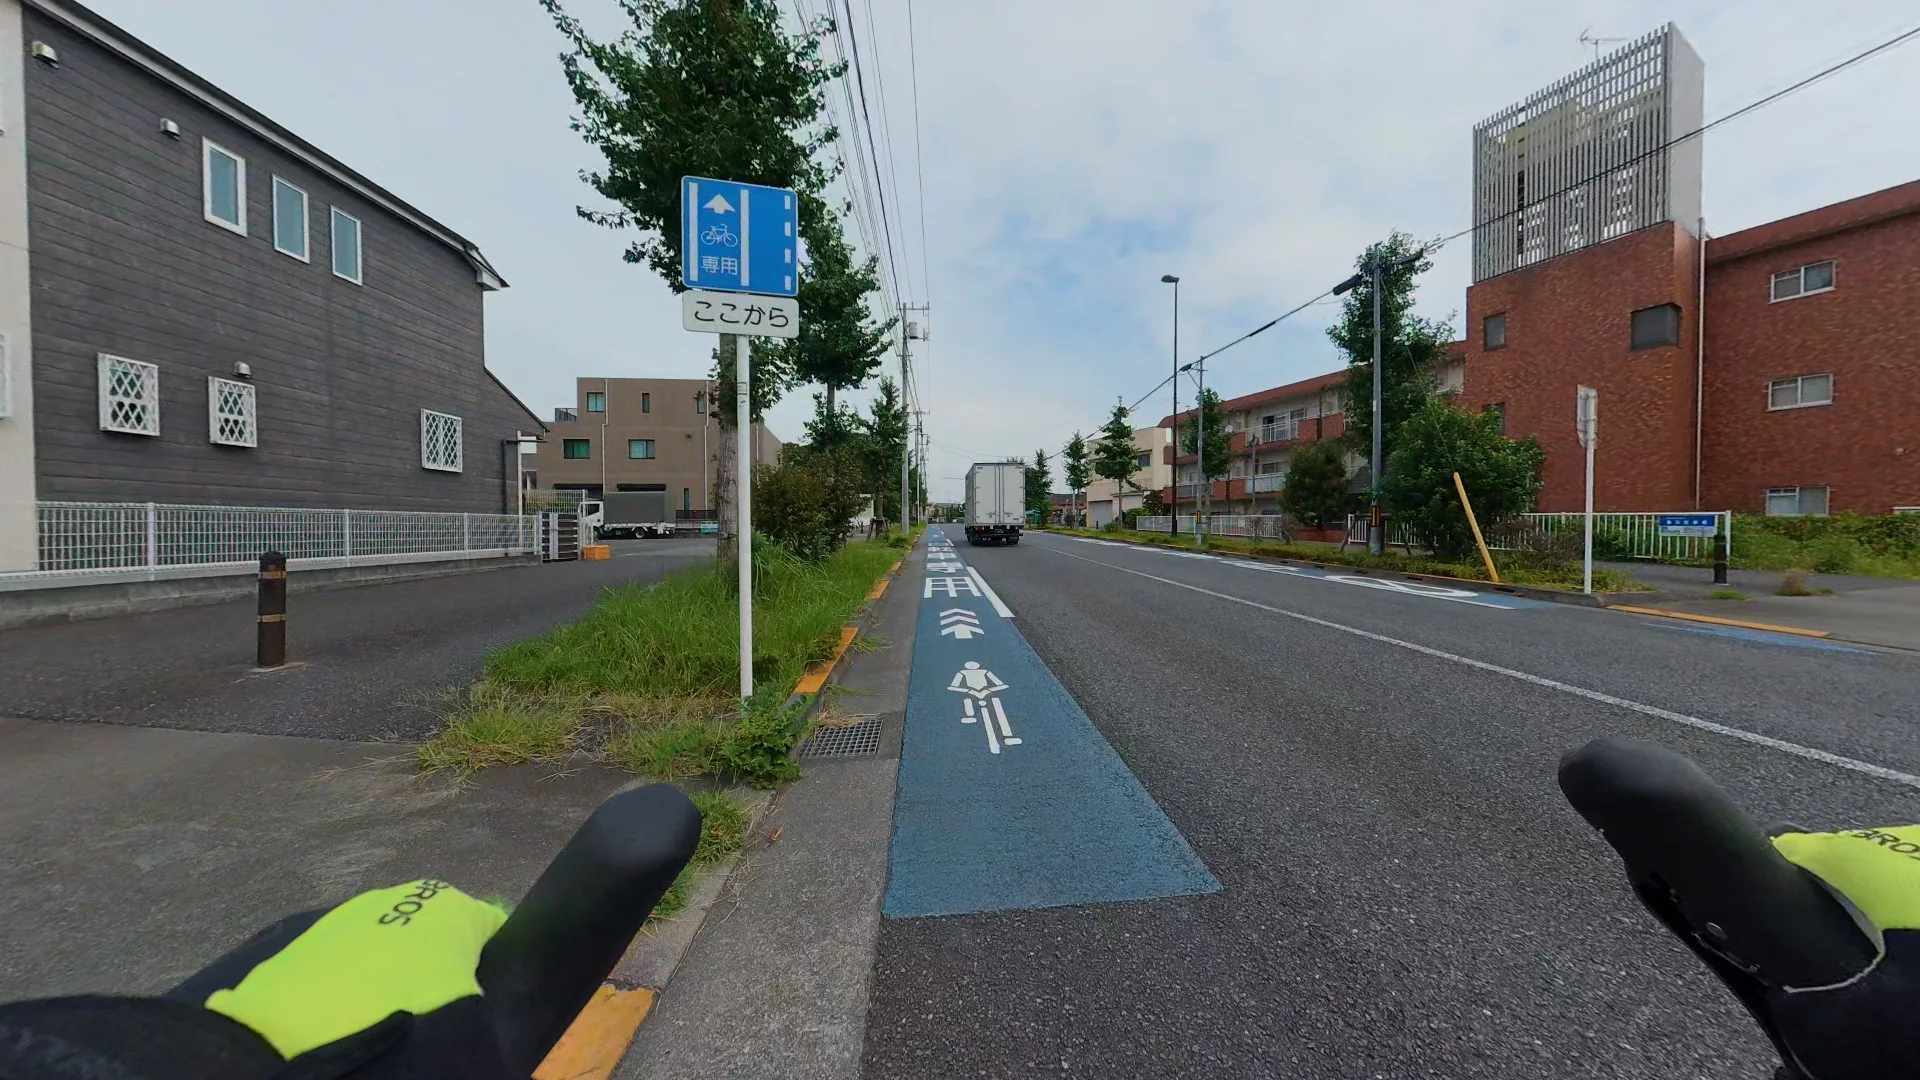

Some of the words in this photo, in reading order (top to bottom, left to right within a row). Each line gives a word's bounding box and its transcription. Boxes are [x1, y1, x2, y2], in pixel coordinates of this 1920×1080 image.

[700, 255, 738, 276] 専用
[694, 300, 789, 328] ここから
